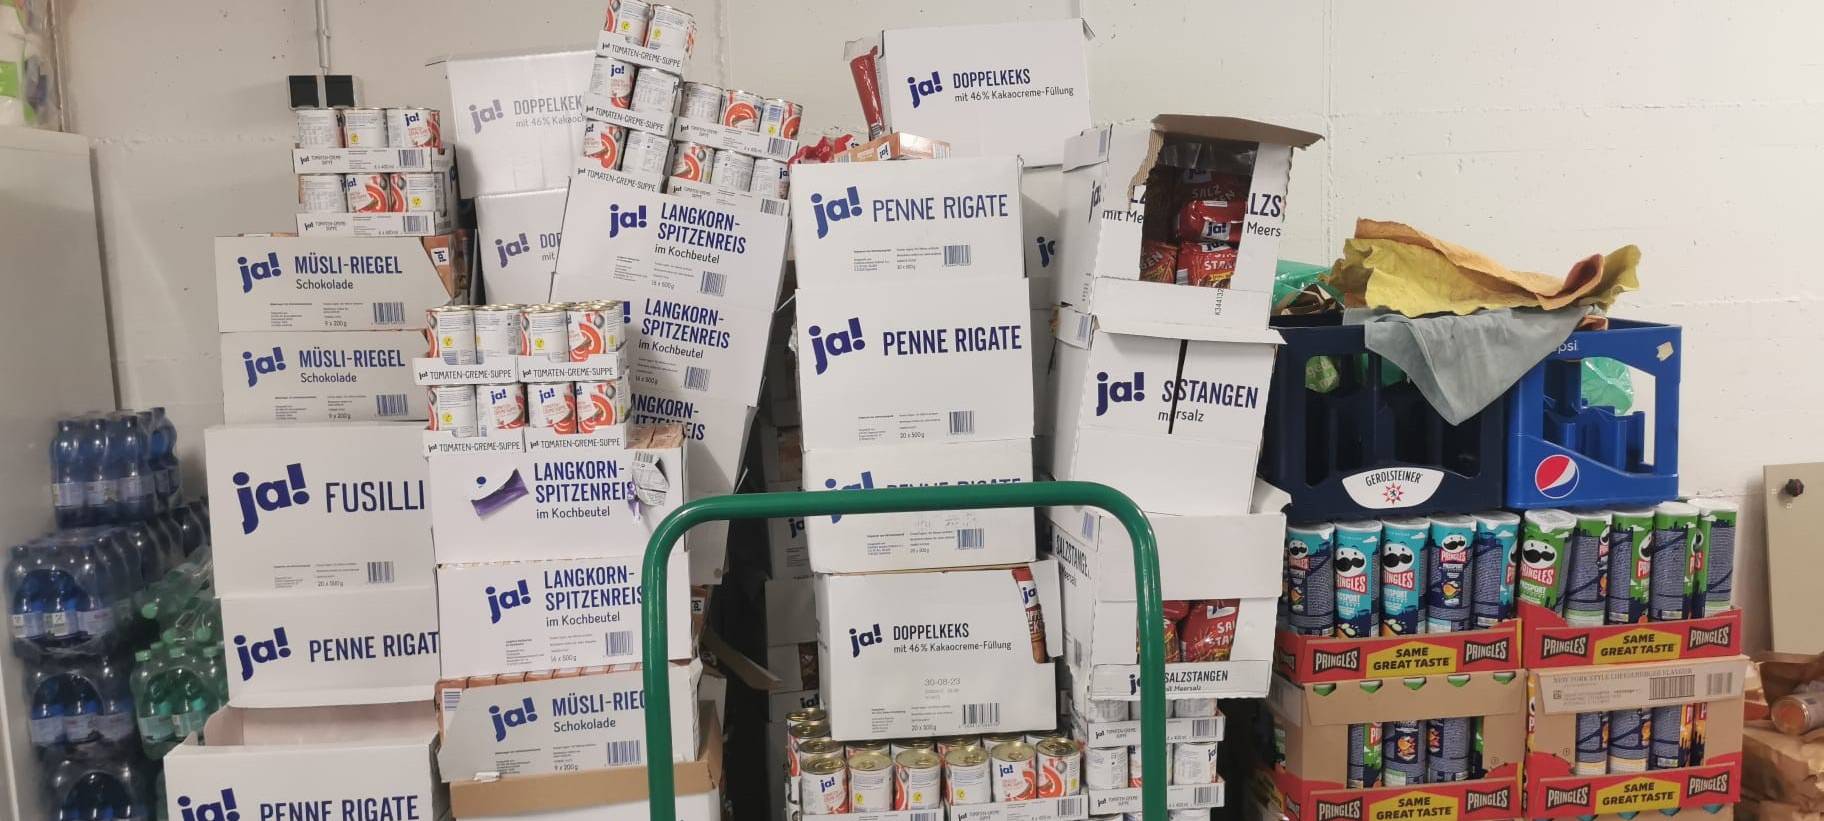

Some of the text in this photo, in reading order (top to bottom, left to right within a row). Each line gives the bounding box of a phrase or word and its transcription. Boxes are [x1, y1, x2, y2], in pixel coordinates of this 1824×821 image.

[611, 44, 681, 68] TOMATEN-CREME-SUPPE
[610, 65, 625, 77] ja!
[907, 68, 1031, 109] ja! DOPPELKEKS
[954, 86, 1074, 102] mit 46% Kakaocreme-Füllung
[405, 112, 419, 127] ja!
[468, 94, 583, 135] ja! DOPPELKEK
[515, 116, 532, 127] mit
[531, 115, 552, 127] 46%
[595, 107, 665, 132] TOMATEN-CREME-SUPPE
[587, 169, 656, 192] TOMATEN-CREME-SUPPE
[779, 168, 789, 179] ja
[609, 202, 741, 238] ja! LANGKORN-
[810, 186, 1008, 239] ja! PENNE RIGATE
[658, 223, 746, 254] SPITZENREIS
[495, 233, 530, 268] ja!
[541, 251, 555, 262] mit
[655, 244, 720, 265] im Kochbeutel
[237, 251, 403, 293] ja! MÜSLI-RIEGEL
[295, 278, 355, 291] Schokolade
[645, 298, 724, 327] LANGKORN-
[641, 318, 731, 350] SPITZENREIS
[638, 339, 704, 360] im Kochbeutel
[808, 316, 1022, 375] ja! PENNE RIGATE
[1557, 339, 1578, 354] psi
[242, 346, 406, 387] ja! MÜSLI-RIEGEL
[430, 369, 512, 380] TOMATEN-CREME-SUPPE
[533, 367, 613, 378] TOMATEN-CREME-SUPPE
[300, 372, 357, 384] Schokolade
[490, 389, 507, 405] ja!
[539, 388, 555, 404] ja!
[1096, 371, 1145, 417] ja!
[630, 393, 700, 419] ANGKORN-
[439, 441, 520, 452] TOMATEN-CREME-SUPPE
[540, 437, 621, 448] TOMATEN-CREME-SUPPE
[534, 459, 625, 482] LANGKORN-
[1365, 471, 1422, 487] GEROLSTEINER
[232, 463, 425, 535] ja! FUSILLI
[536, 506, 610, 519] im Kochbeutel
[789, 518, 805, 539] ja
[1055, 535, 1092, 581] SALZSTANGE
[1441, 550, 1467, 562] PRINGLES
[485, 565, 635, 625] ja! LANGKORN-
[1022, 586, 1036, 605] ja
[546, 612, 620, 628] im Kochbeutel
[849, 622, 970, 658] ja! DOPPELKEKS
[1543, 636, 1586, 656] PRINGLES
[1623, 634, 1655, 643] SAME
[1690, 627, 1729, 647] PRINGLES
[233, 626, 291, 682] ja!
[309, 635, 376, 663] PENNE
[893, 640, 1012, 654] mit 46% Kakaocreme-Füllung
[1395, 647, 1428, 658] SAME
[1465, 640, 1507, 660] PRINGLES
[1601, 644, 1674, 656] GREAT TASTE
[1315, 650, 1357, 670] PRINGLES
[1373, 658, 1449, 670] GREAT TASTE
[924, 677, 961, 687] 30-08-23
[1164, 670, 1228, 683] SALZSTANGEN
[488, 696, 538, 742] ja!
[553, 717, 616, 733] Schokolade
[999, 763, 1014, 778] ja!
[819, 776, 835, 792] ja!
[1623, 782, 1655, 792] SAME
[1689, 774, 1728, 793] PRINGLES
[1398, 796, 1430, 807] SAME
[1467, 789, 1508, 809] PRINGLES
[1547, 788, 1588, 808] PRINGLES
[1602, 791, 1674, 806] GREAT TASTE
[260, 800, 333, 821] PENNE
[341, 795, 420, 821] RIGATE
[1318, 801, 1360, 820] PRINGLES
[1376, 807, 1451, 820] GREAT TASTE
